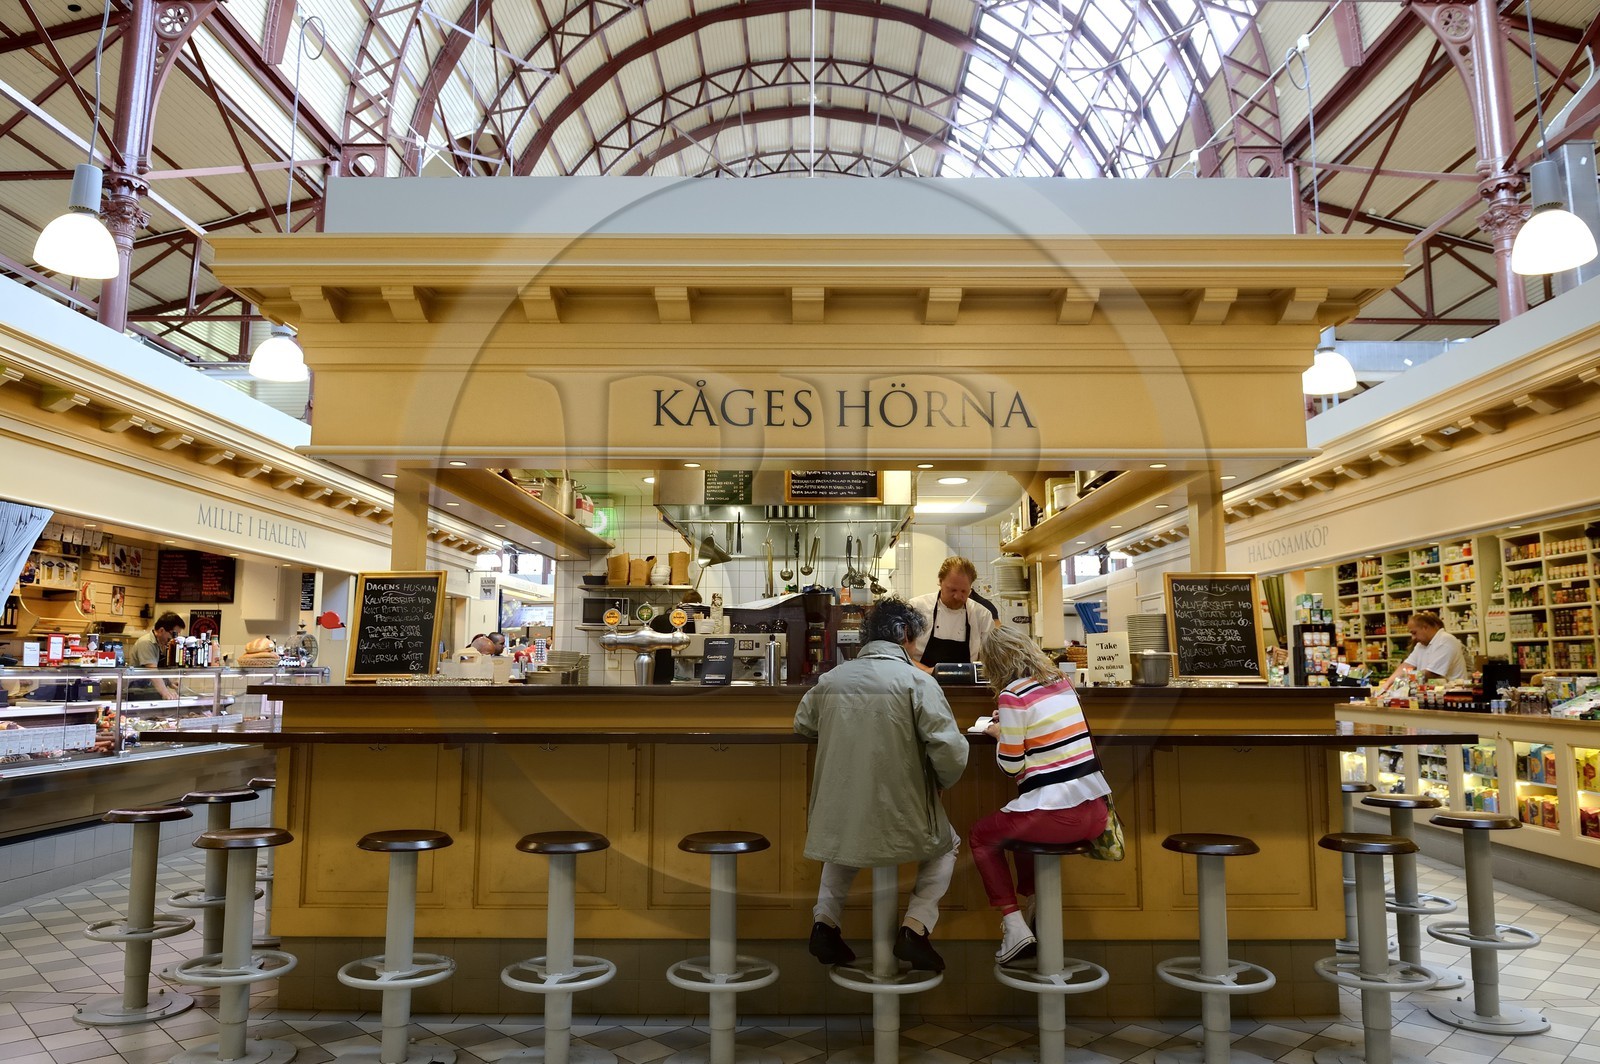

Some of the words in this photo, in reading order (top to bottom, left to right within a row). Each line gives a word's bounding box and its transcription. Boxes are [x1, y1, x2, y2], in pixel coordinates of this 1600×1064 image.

[652, 379, 813, 429] KÅGES
[835, 382, 1037, 429] HÖRNA
[197, 503, 243, 534] MILLE
[248, 516, 252, 536] I
[258, 518, 308, 549] HALLEN
[366, 582, 400, 591] DAGENS
[403, 584, 437, 593] HUSMAN
[1173, 582, 1209, 592] DAGENS
[1175, 610, 1194, 618] KOKT
[1196, 609, 1228, 618] POTATIS
[366, 625, 399, 634] DAGENS
[400, 624, 421, 632] SOPPA
[1180, 627, 1216, 636] DAGENS
[1218, 628, 1240, 636] SOPPA
[394, 640, 404, 649] PÅ
[1216, 644, 1228, 656] PÅ
[1230, 644, 1247, 654] DET
[401, 650, 424, 661] SÄTTET
[1097, 654, 1119, 662] away"
